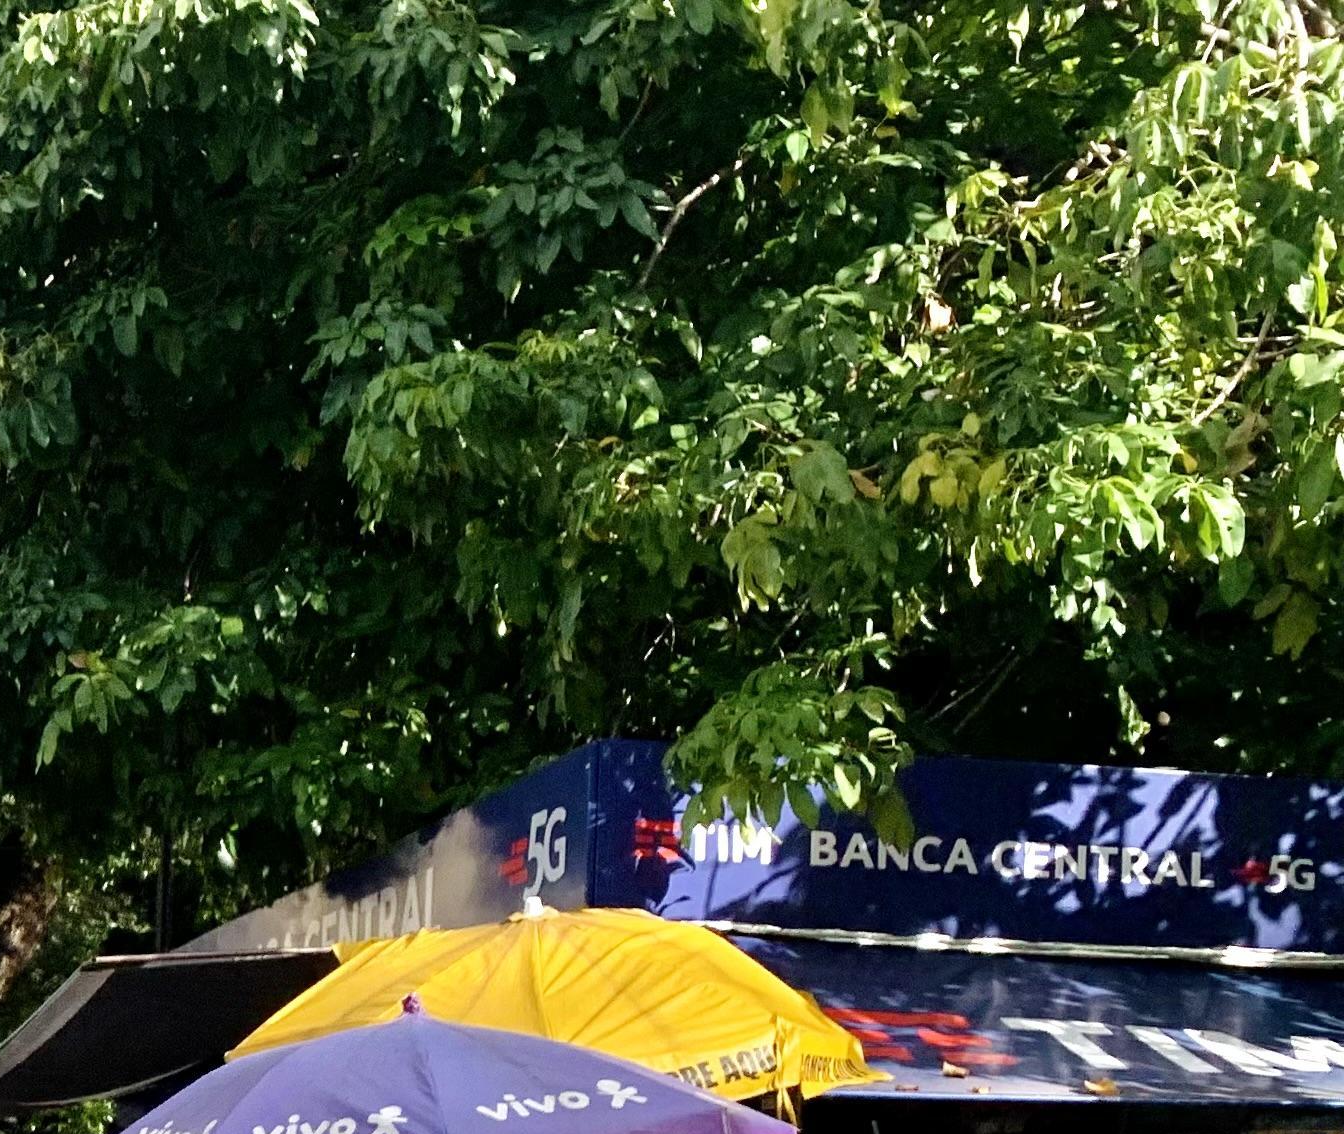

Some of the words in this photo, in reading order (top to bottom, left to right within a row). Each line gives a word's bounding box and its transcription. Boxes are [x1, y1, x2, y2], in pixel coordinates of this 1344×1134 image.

[524, 806, 567, 897] 5G
[691, 822, 773, 865] TIM
[809, 829, 978, 875] BANCA
[991, 840, 1215, 888] CENTRAL
[1267, 854, 1315, 894] 5G
[720, 1041, 778, 1085] AQU
[475, 1091, 590, 1121] vivo
